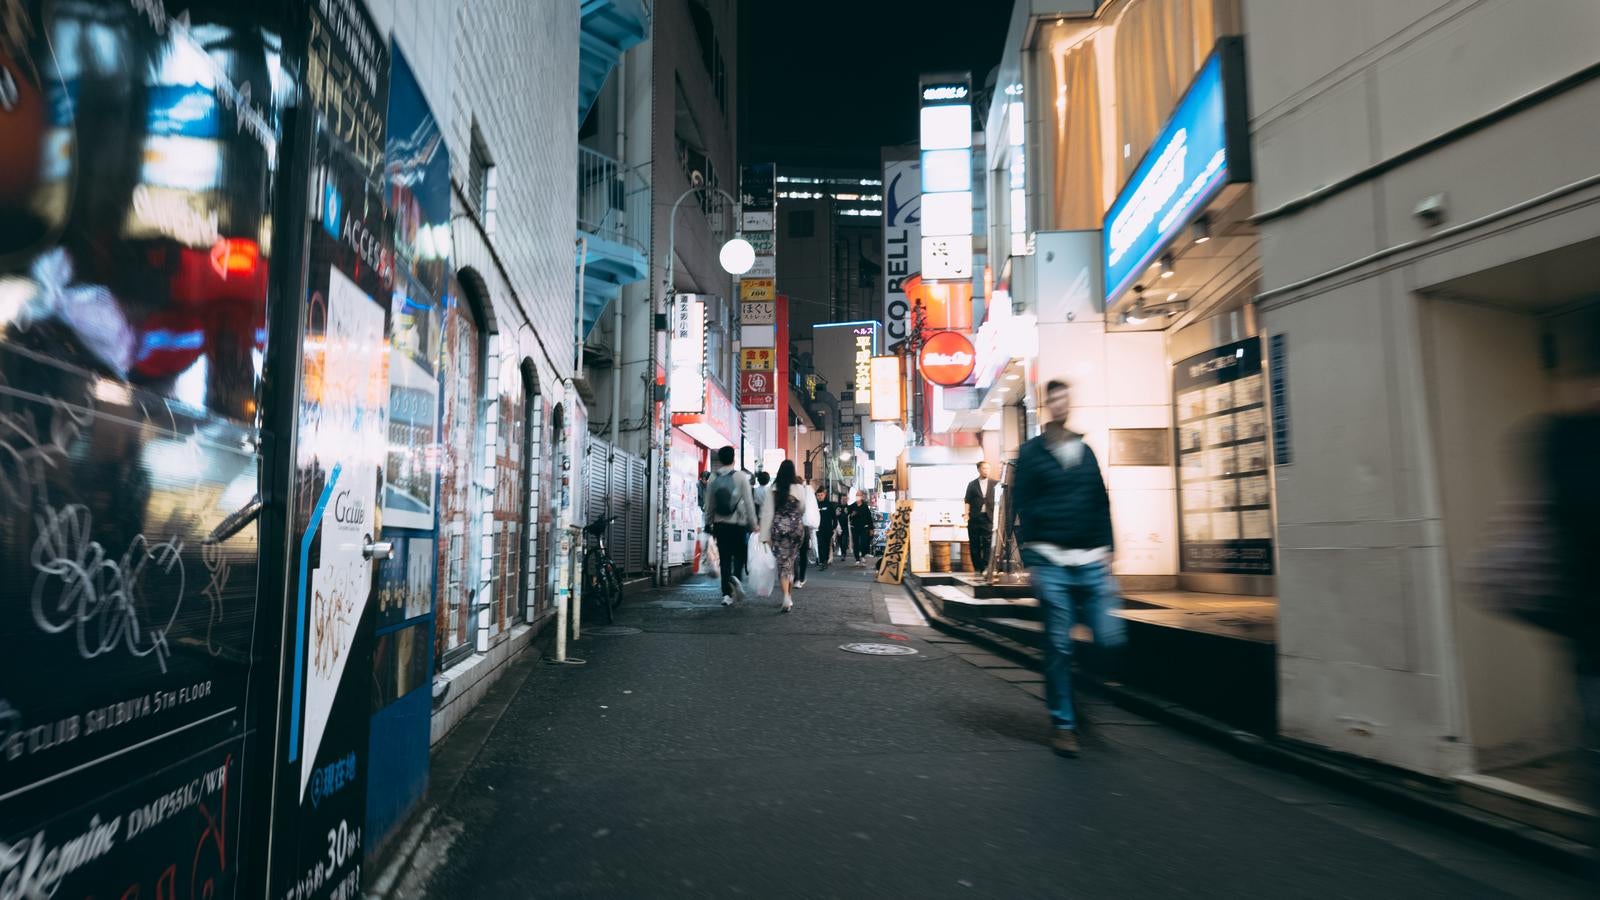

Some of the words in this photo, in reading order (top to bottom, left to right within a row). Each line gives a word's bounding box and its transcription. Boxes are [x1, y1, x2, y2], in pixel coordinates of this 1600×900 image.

[343, 210, 388, 278] ACCESS
[887, 229, 908, 294] BELL
[679, 295, 689, 338] 道玄坂小路
[743, 303, 772, 314] ほぐし
[887, 300, 908, 355] ACO
[853, 327, 874, 335] ヘルス
[746, 350, 769, 360] 金券
[751, 375, 763, 388] 油
[84, 694, 151, 737] SHIBUYA
[153, 690, 177, 714] 5TH
[179, 680, 212, 704] FLOOR
